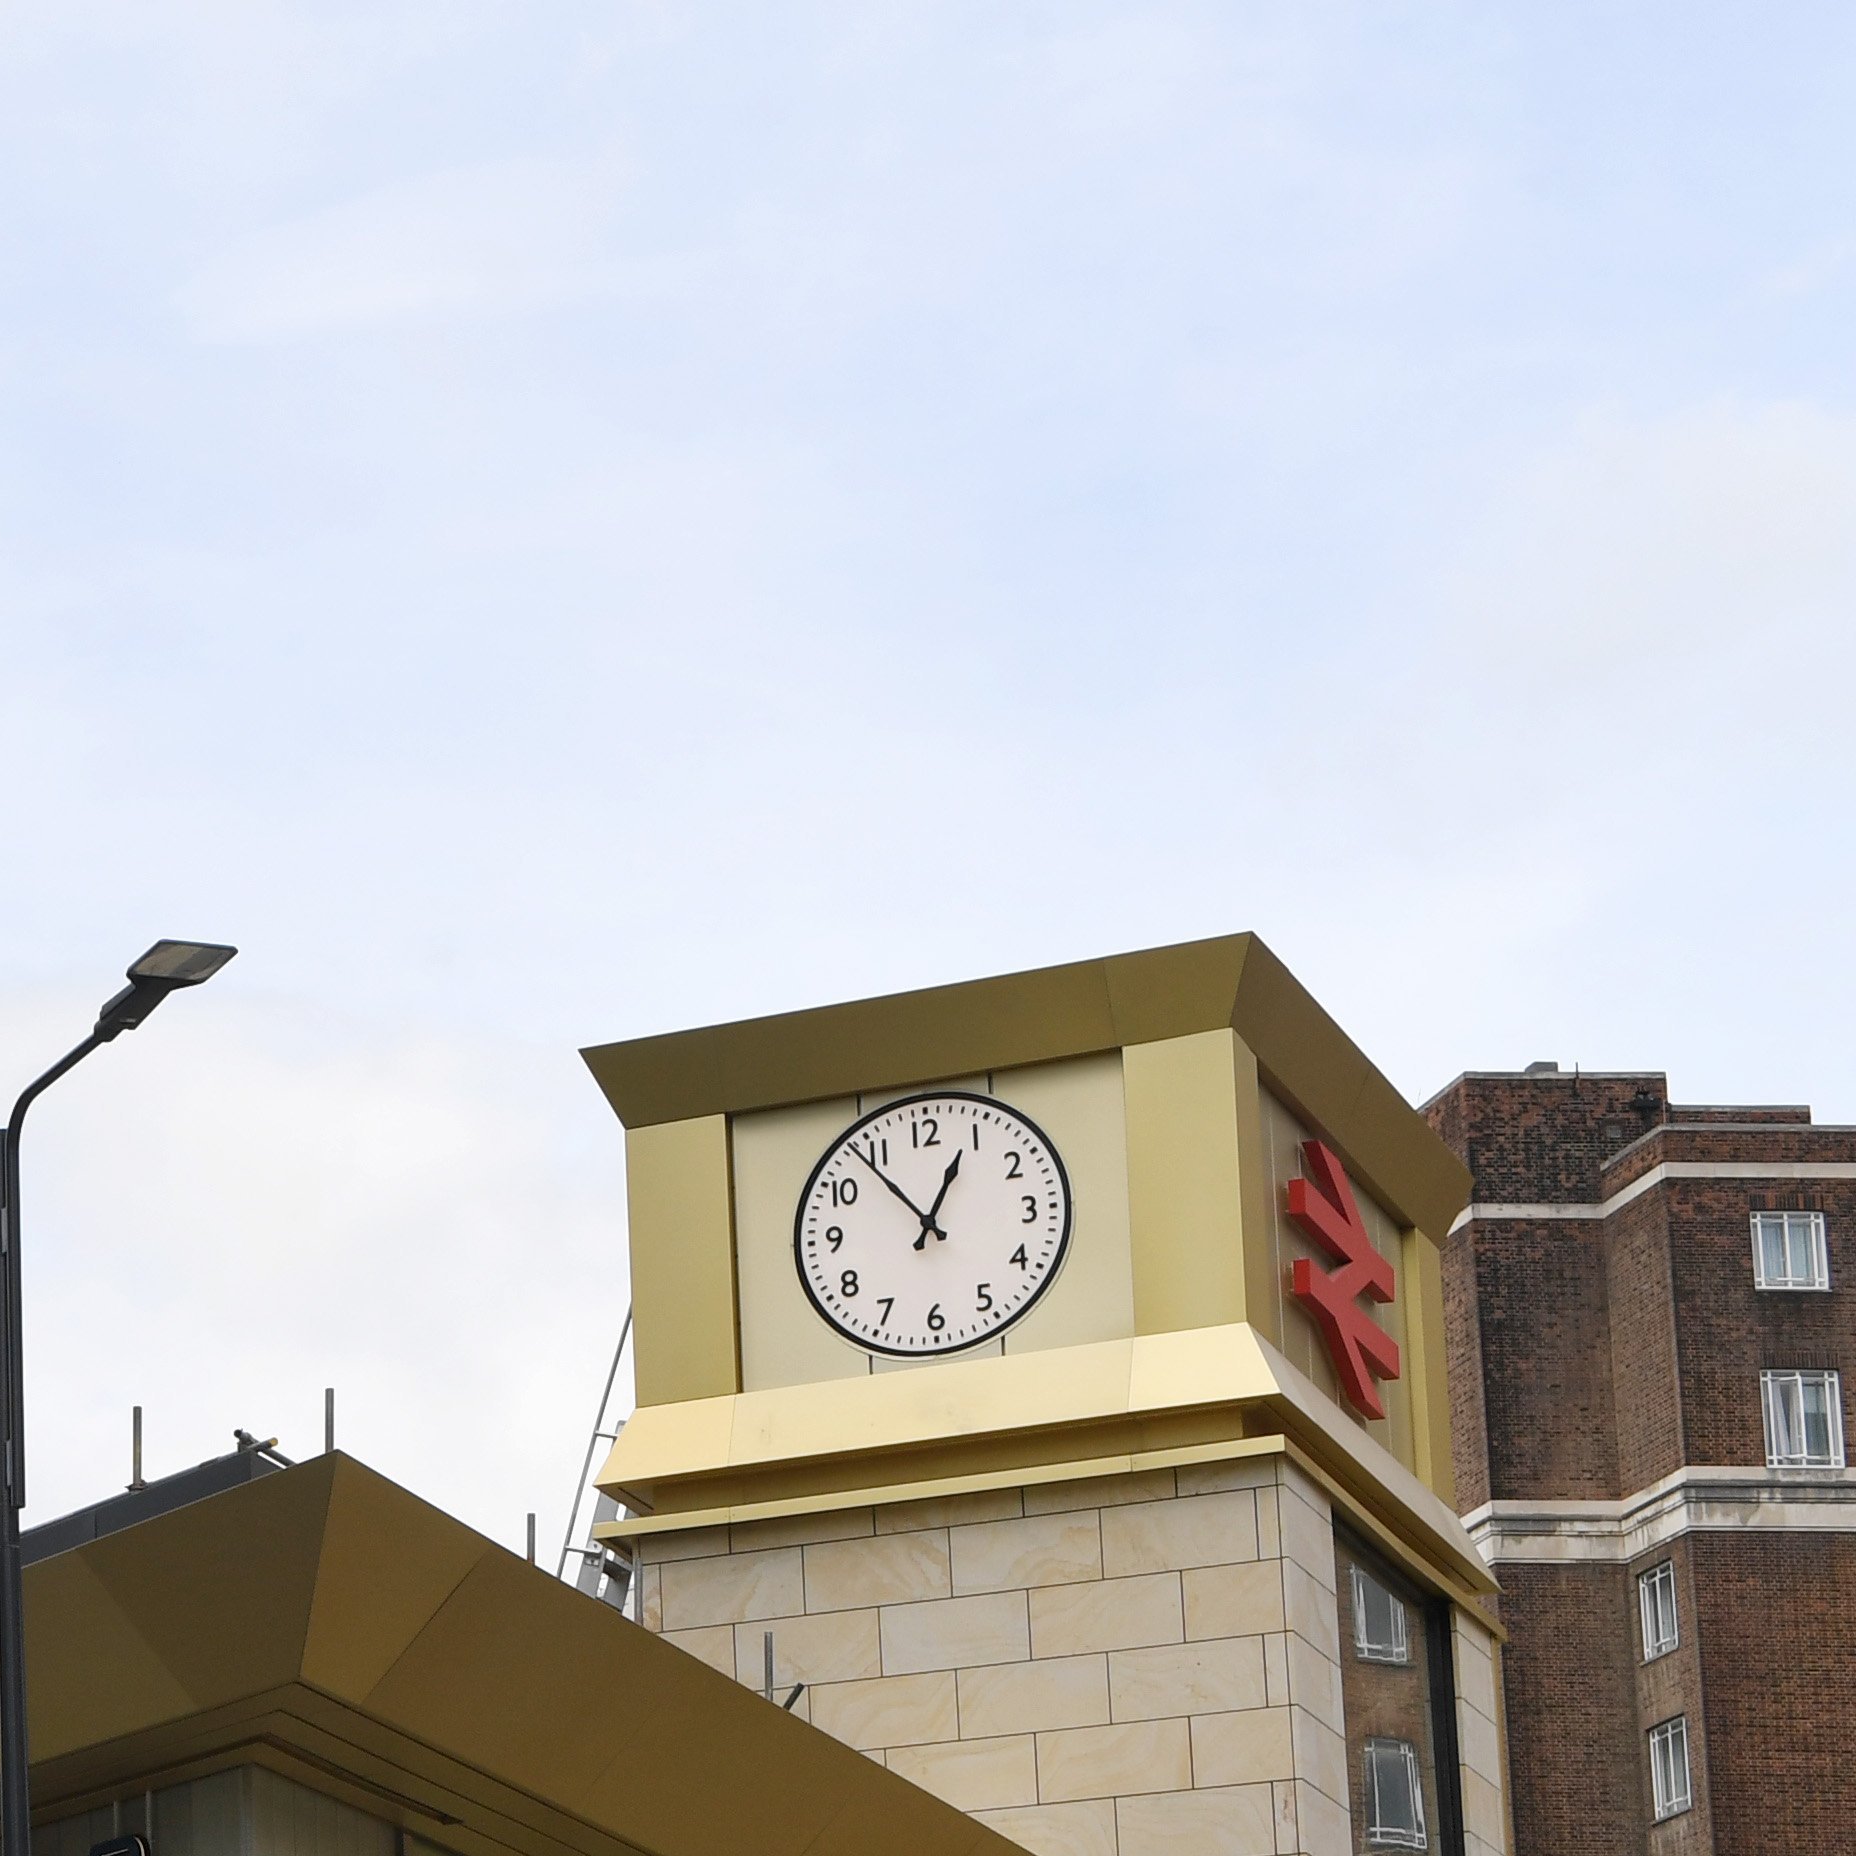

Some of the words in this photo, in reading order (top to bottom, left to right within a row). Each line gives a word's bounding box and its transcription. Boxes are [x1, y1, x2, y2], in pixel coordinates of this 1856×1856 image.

[912, 1118, 941, 1148] 12
[972, 1123, 979, 1151] 1
[870, 1138, 888, 1167] 11
[1004, 1151, 1024, 1180] 2
[832, 1178, 858, 1207] 10
[1021, 1195, 1037, 1223] 3
[825, 1226, 843, 1253] 9
[1008, 1243, 1028, 1271] 4
[840, 1269, 859, 1297] 8
[975, 1283, 993, 1311] 5
[876, 1297, 894, 1326] 7
[927, 1303, 945, 1330] 6
